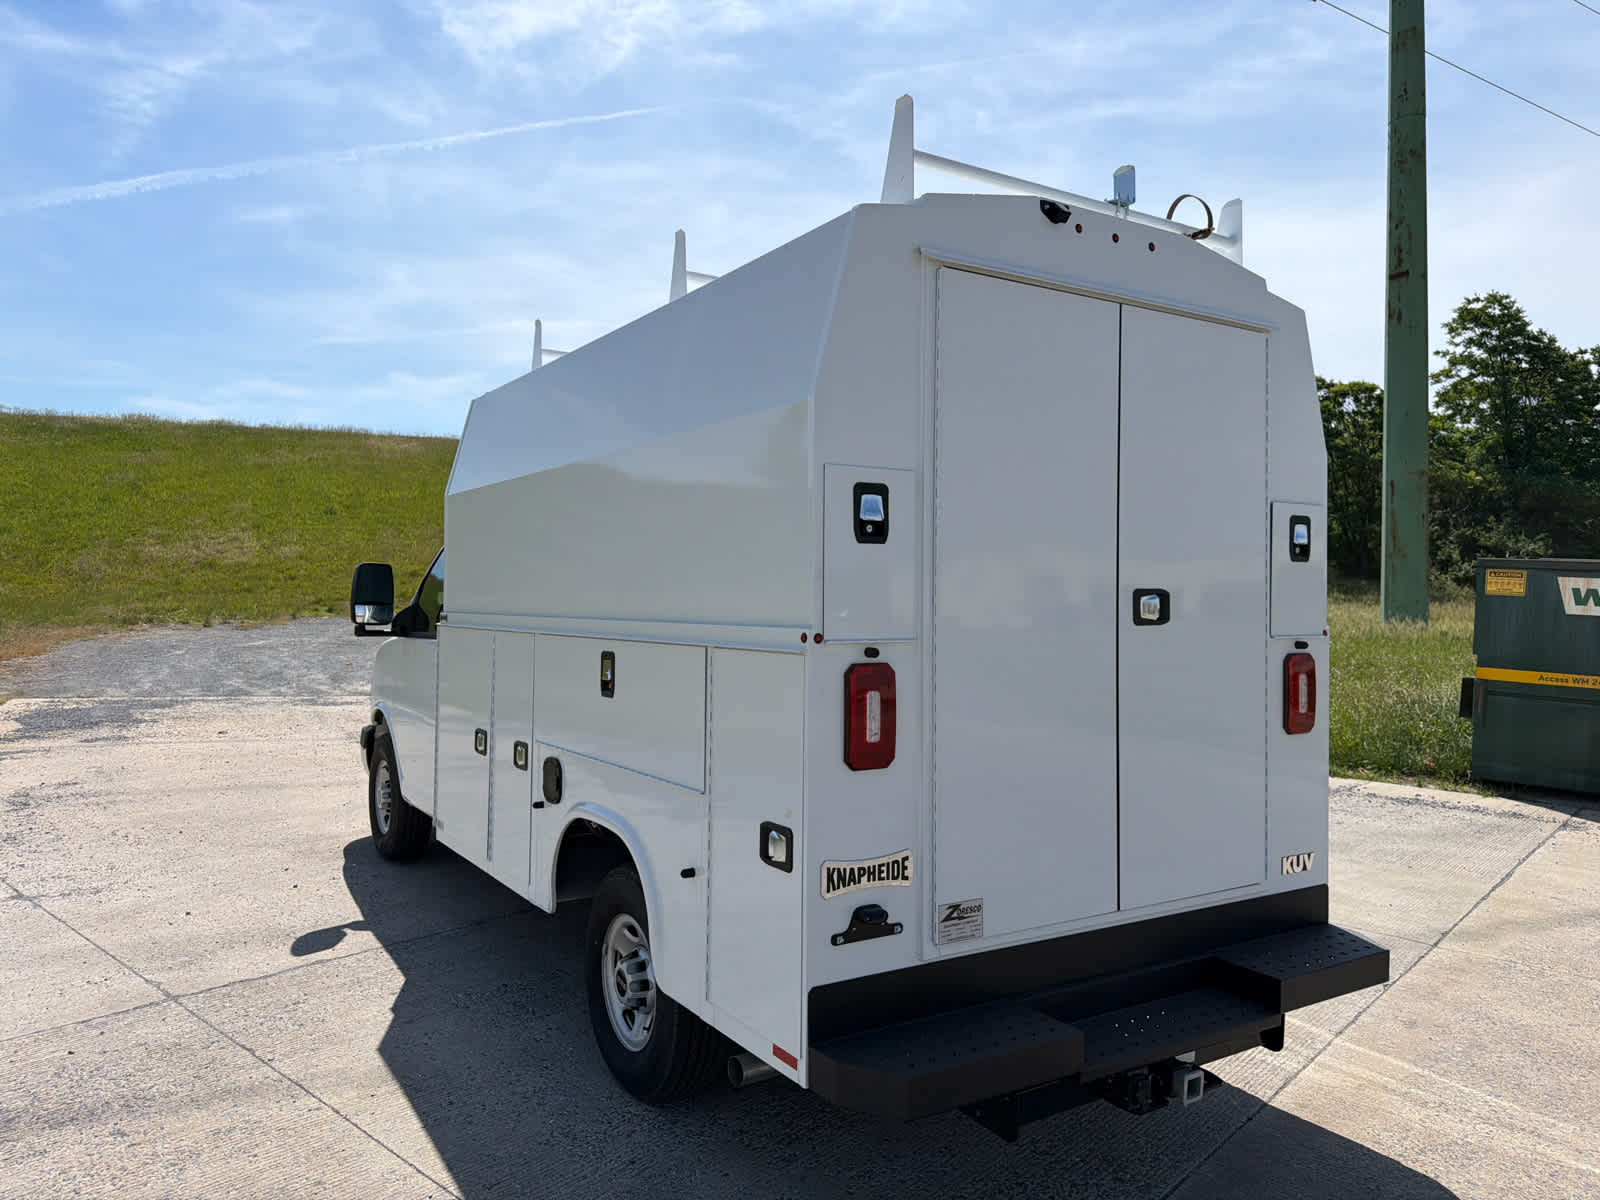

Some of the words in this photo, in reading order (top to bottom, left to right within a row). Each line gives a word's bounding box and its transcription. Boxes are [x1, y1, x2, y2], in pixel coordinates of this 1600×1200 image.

[1537, 674, 1569, 683] Access
[1571, 677, 1590, 685] WM
[826, 855, 910, 893] KNAPHEIDE
[1281, 852, 1316, 876] KUV
